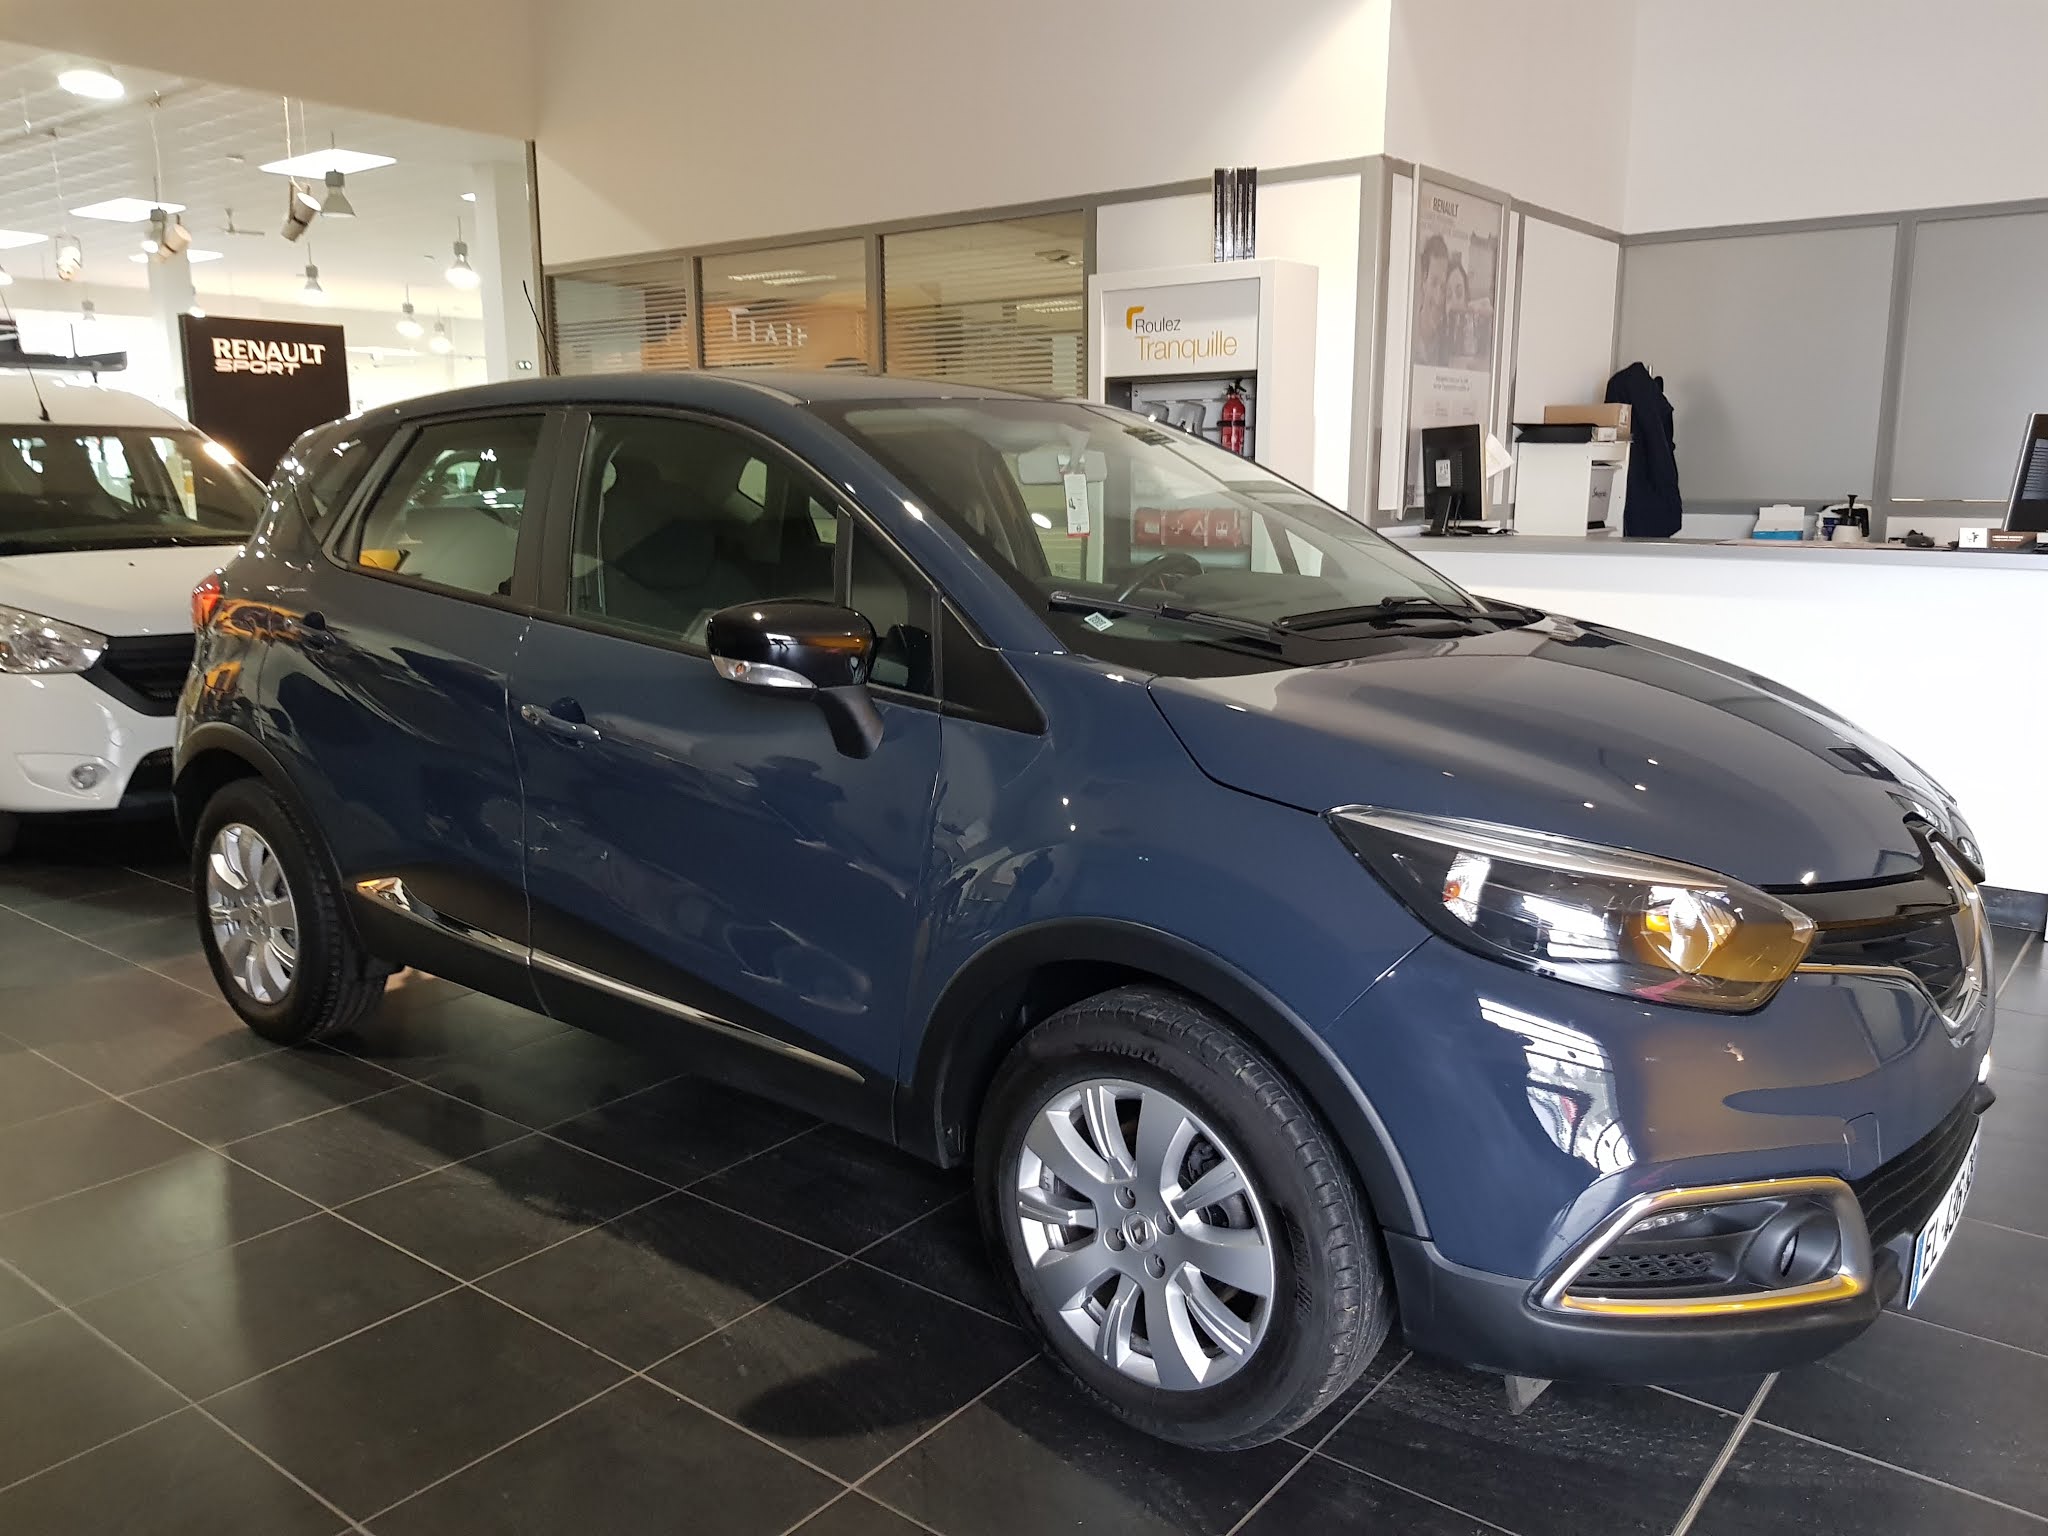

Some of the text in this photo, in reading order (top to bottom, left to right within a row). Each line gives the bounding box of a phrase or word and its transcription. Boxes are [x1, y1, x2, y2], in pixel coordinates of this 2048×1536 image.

[1134, 316, 1182, 334] Roulez
[211, 337, 326, 365] RENAULT
[1135, 330, 1238, 365] Tranquille
[214, 358, 301, 376] SPORT
